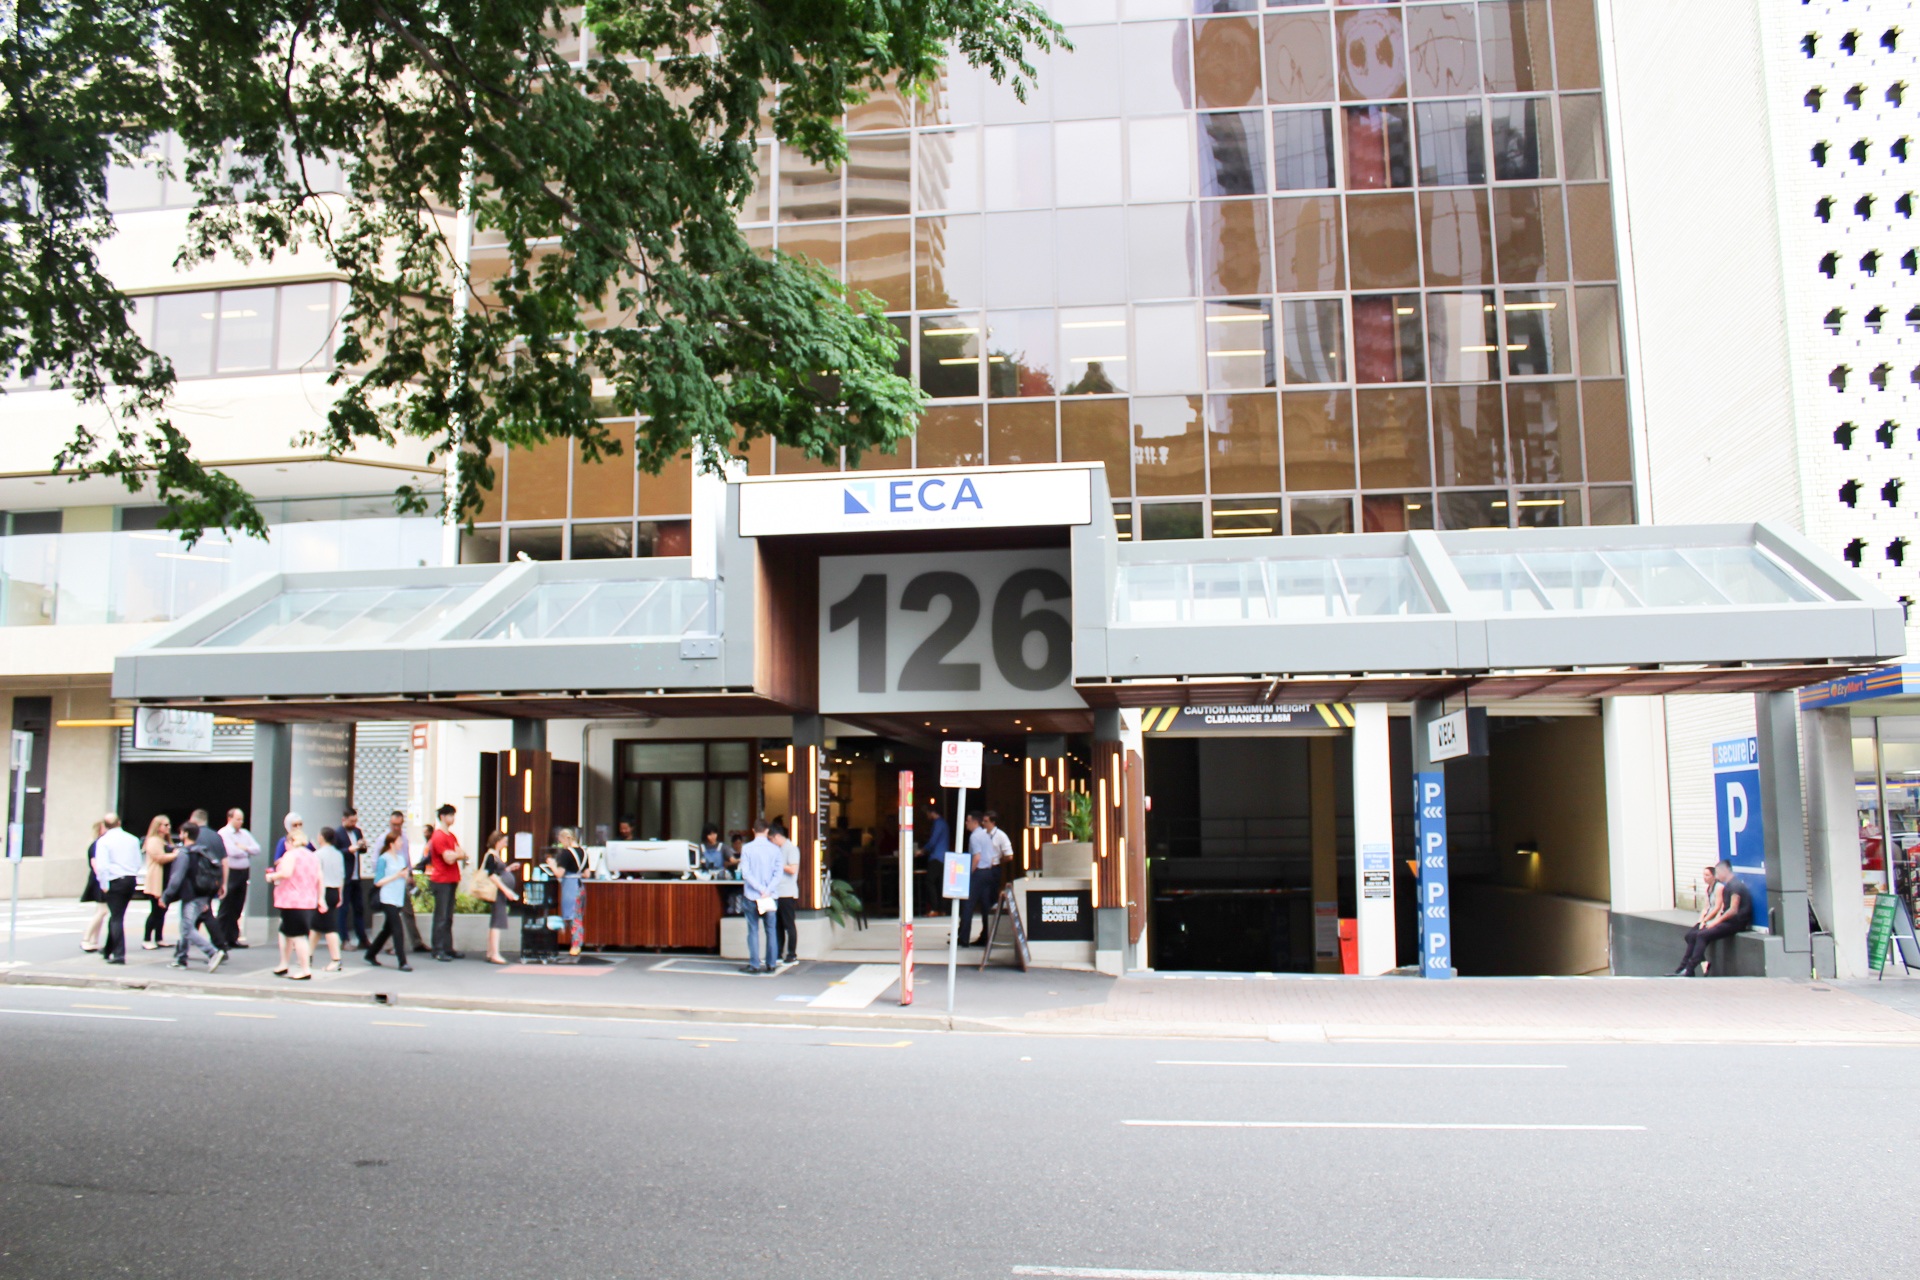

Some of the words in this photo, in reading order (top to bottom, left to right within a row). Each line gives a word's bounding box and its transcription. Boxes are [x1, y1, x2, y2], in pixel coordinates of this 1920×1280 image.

[889, 478, 983, 512] ECA
[829, 568, 1072, 693] 126
[1184, 706, 1226, 715] CAUTION
[1228, 705, 1273, 714] MAXIMUM
[1276, 704, 1311, 713] HEIGHT
[1205, 714, 1262, 724] CLEARANCE
[1264, 714, 1291, 723] 2.85M
[1718, 742, 1747, 764] secure
[1749, 740, 1756, 761] P
[1424, 783, 1441, 804] P
[1726, 781, 1748, 857] P
[1426, 832, 1443, 854] P
[1428, 882, 1445, 904] P
[1042, 913, 1077, 922] BOOSTER
[1430, 933, 1446, 954] P
